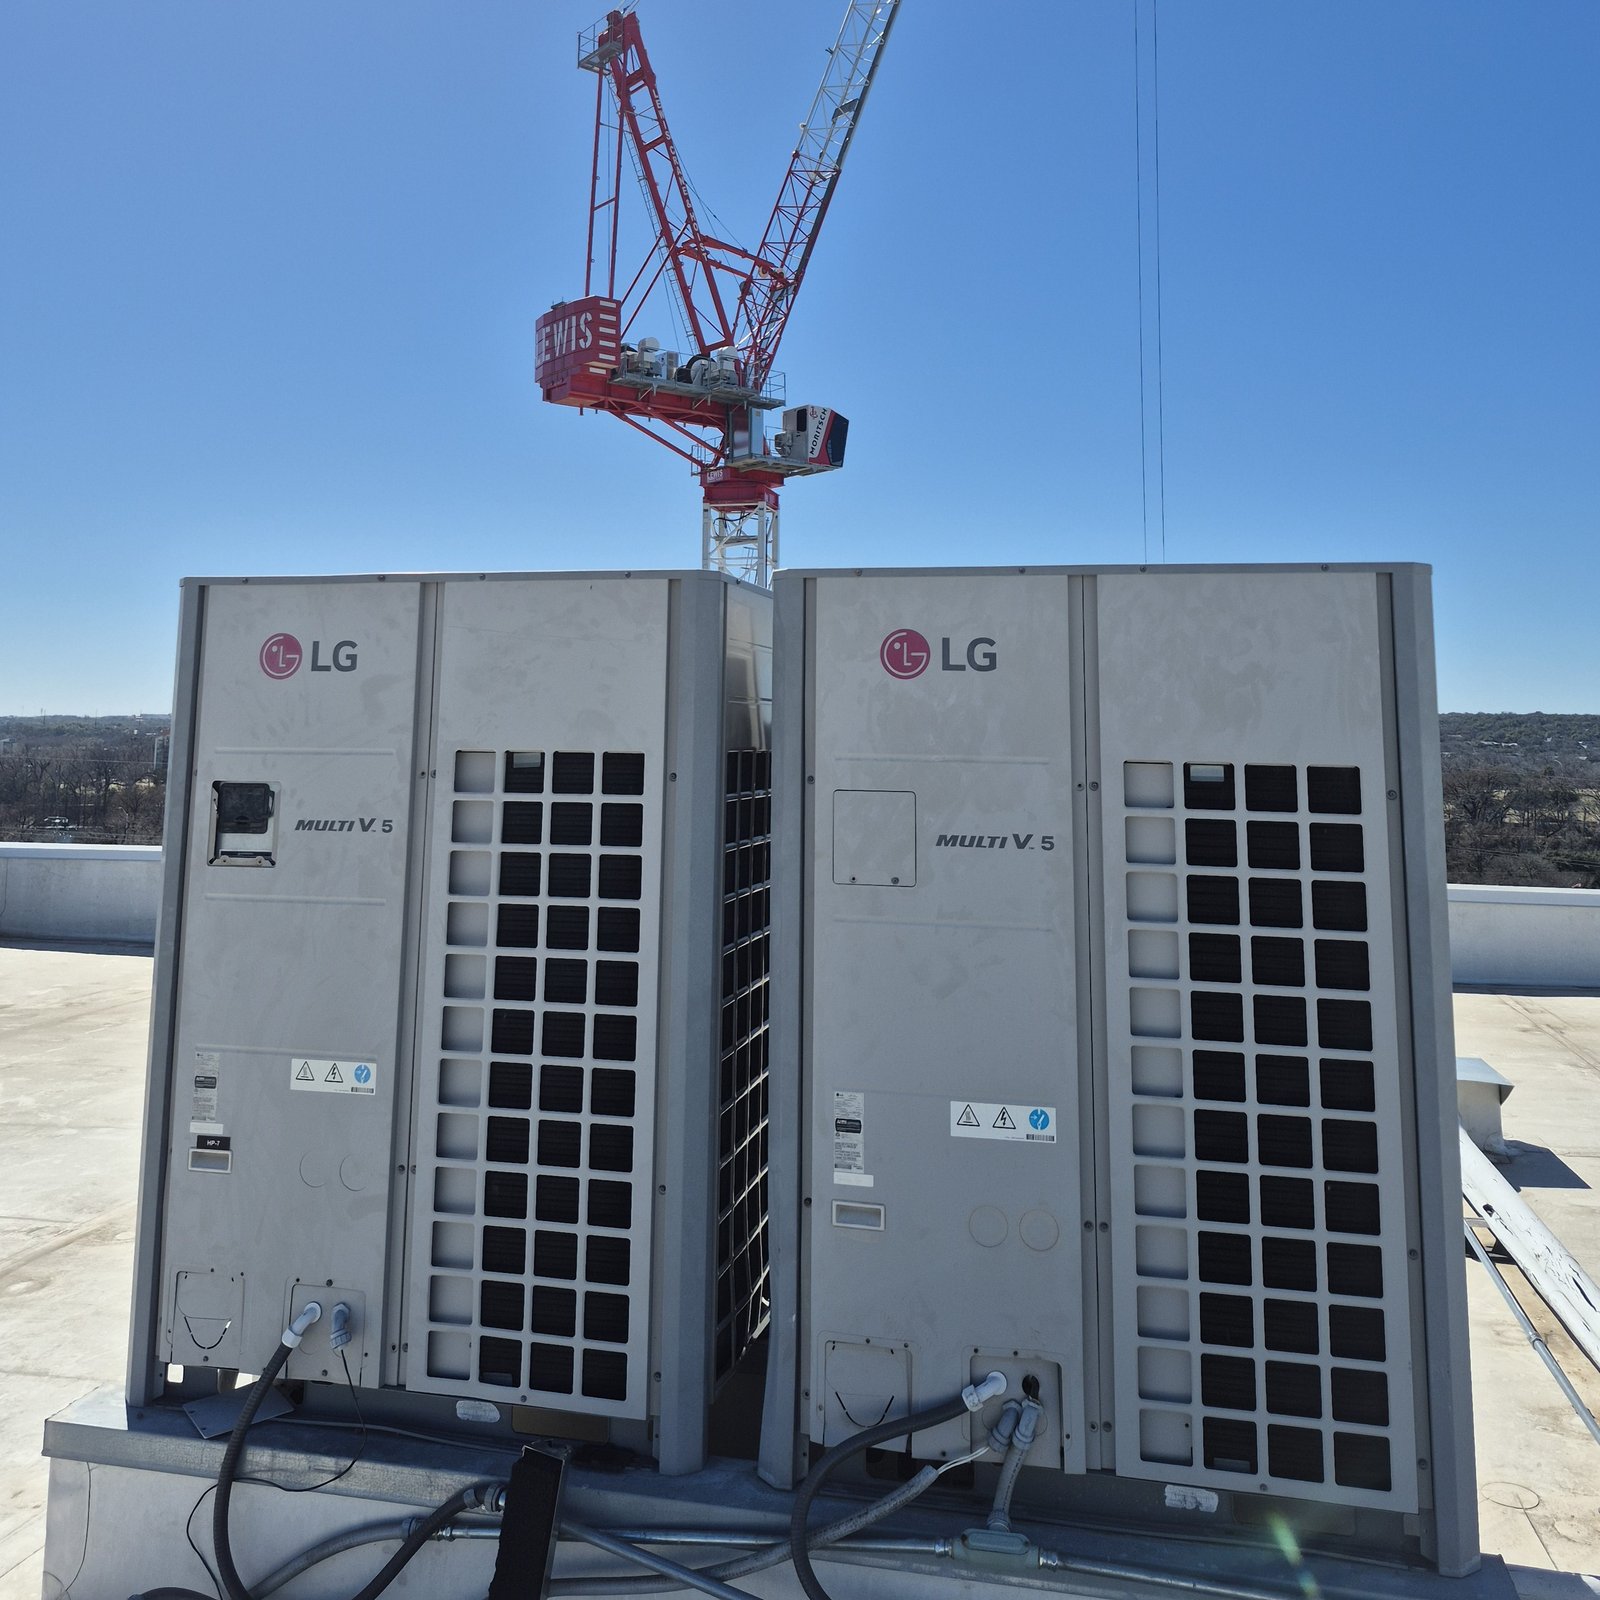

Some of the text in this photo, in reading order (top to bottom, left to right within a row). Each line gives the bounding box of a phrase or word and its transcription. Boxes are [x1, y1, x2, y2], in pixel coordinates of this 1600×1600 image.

[653, 89, 671, 140] LEWIS
[669, 145, 689, 195] CRANE
[689, 212, 708, 261] HOIST
[809, 408, 828, 455] MORITSCH
[311, 640, 358, 672] LG
[942, 637, 997, 672] LG
[294, 819, 355, 832] MULTI
[381, 820, 393, 833] 5
[935, 834, 1008, 849] MULTI
[1041, 835, 1055, 851] 5
